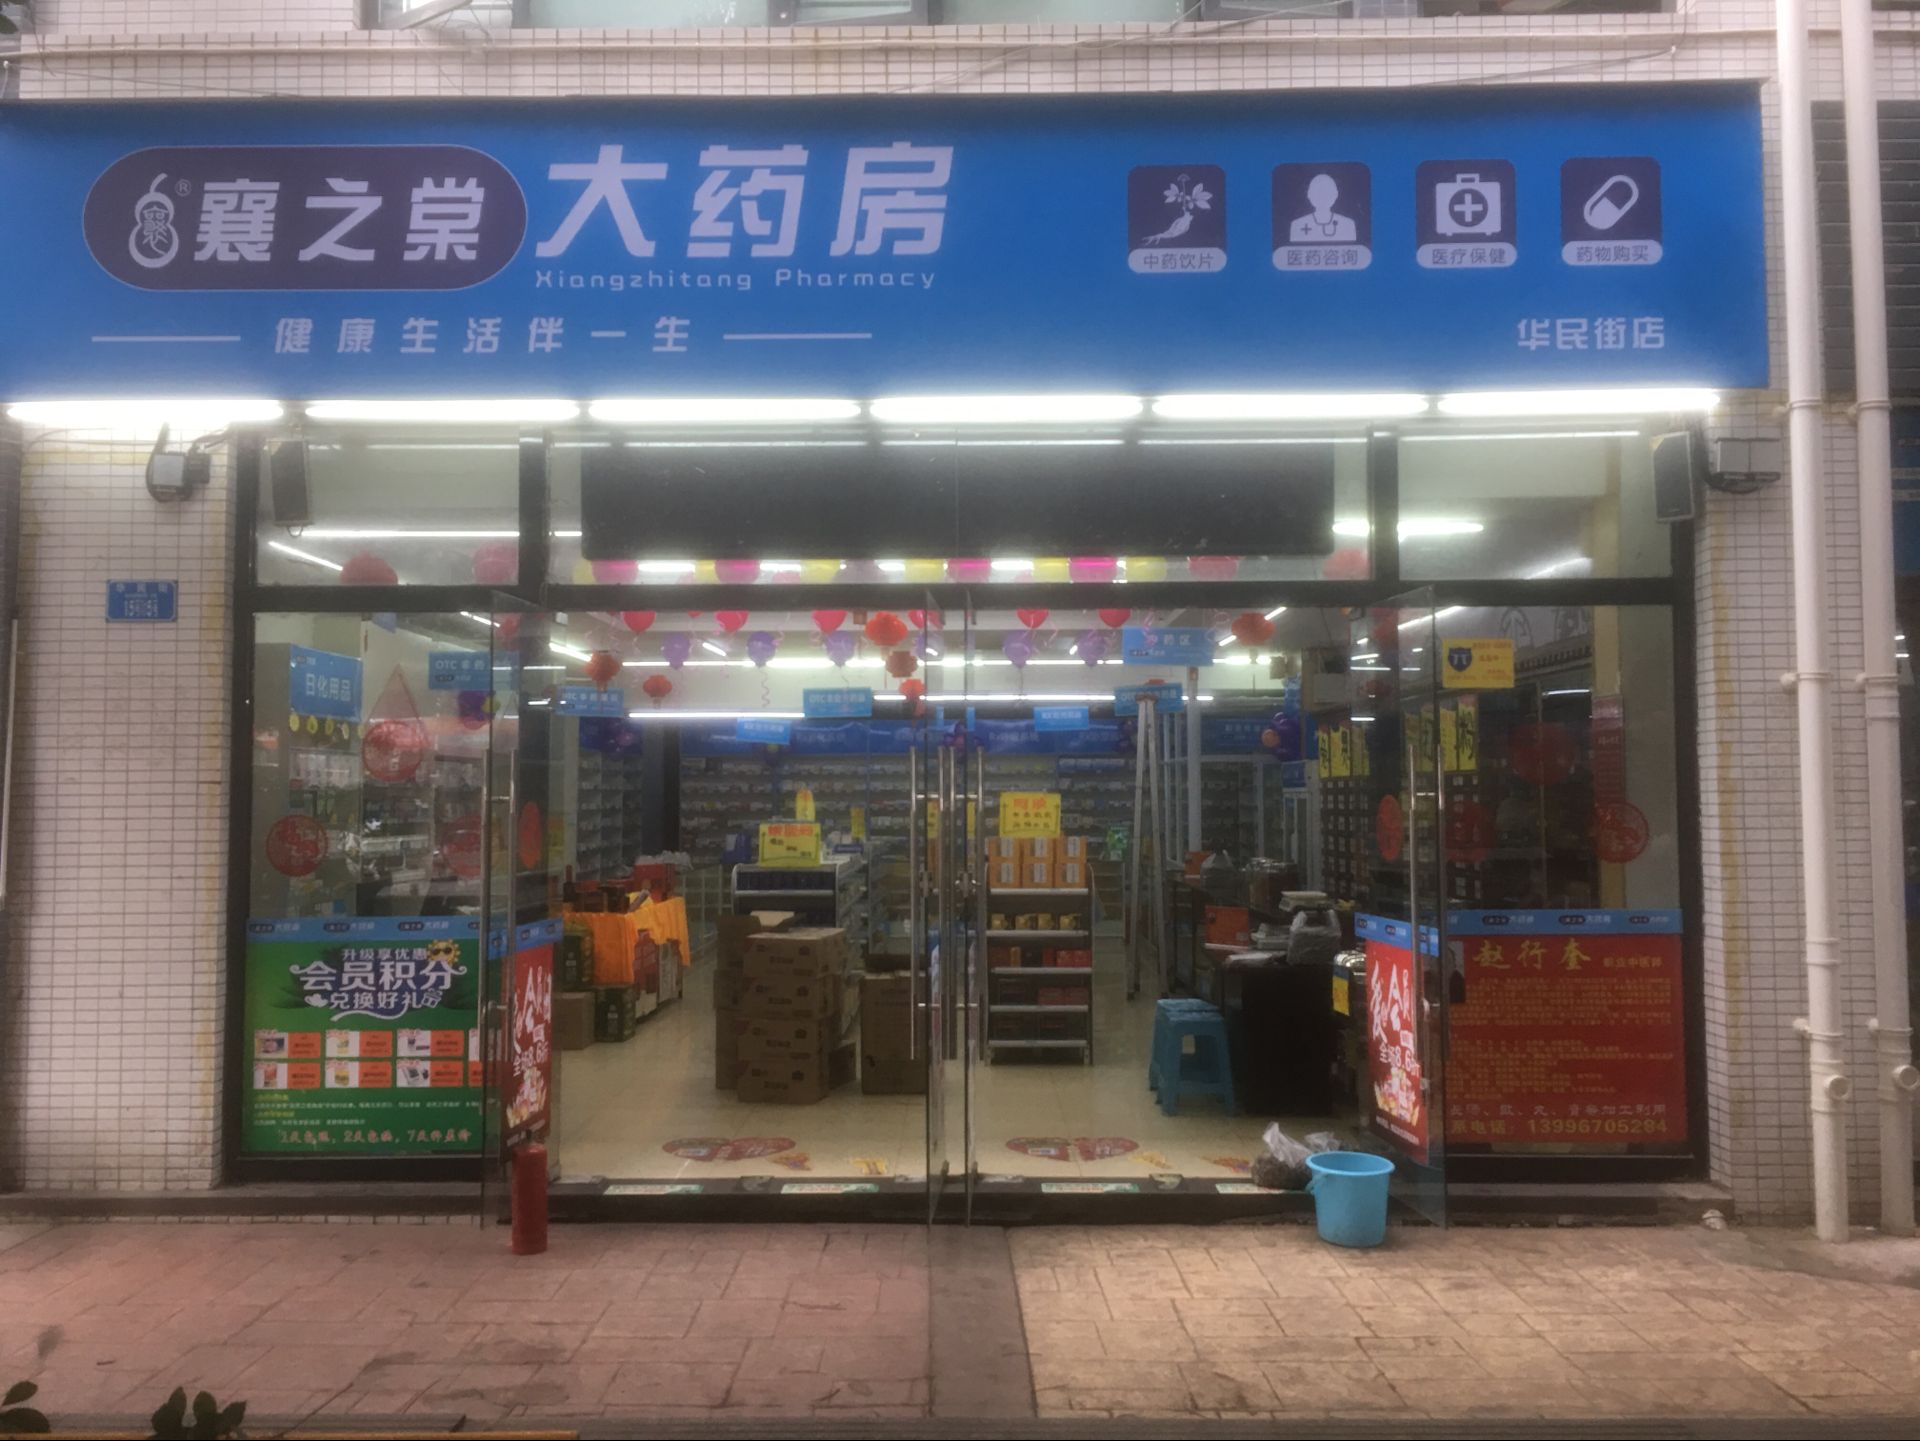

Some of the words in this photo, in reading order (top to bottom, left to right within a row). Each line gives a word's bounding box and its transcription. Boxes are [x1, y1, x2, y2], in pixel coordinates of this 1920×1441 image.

[194, 176, 485, 263] 襄之棠
[535, 141, 954, 258] 大药房
[1142, 252, 1215, 271] 中药饮片
[1286, 248, 1359, 267] 医药咨询
[1431, 246, 1507, 265] 医疗保健
[1575, 244, 1650, 263] 药物购买
[535, 269, 752, 291] Xiangzhitang
[775, 267, 936, 290] Pharmacy
[274, 315, 691, 354] 健康生活伴一生
[1516, 315, 1666, 352] 华民街店
[304, 672, 352, 702] 日化用品
[341, 948, 428, 961] 升级享优惠
[298, 960, 455, 991] 会员积分
[329, 991, 423, 1010] 兑换好礼
